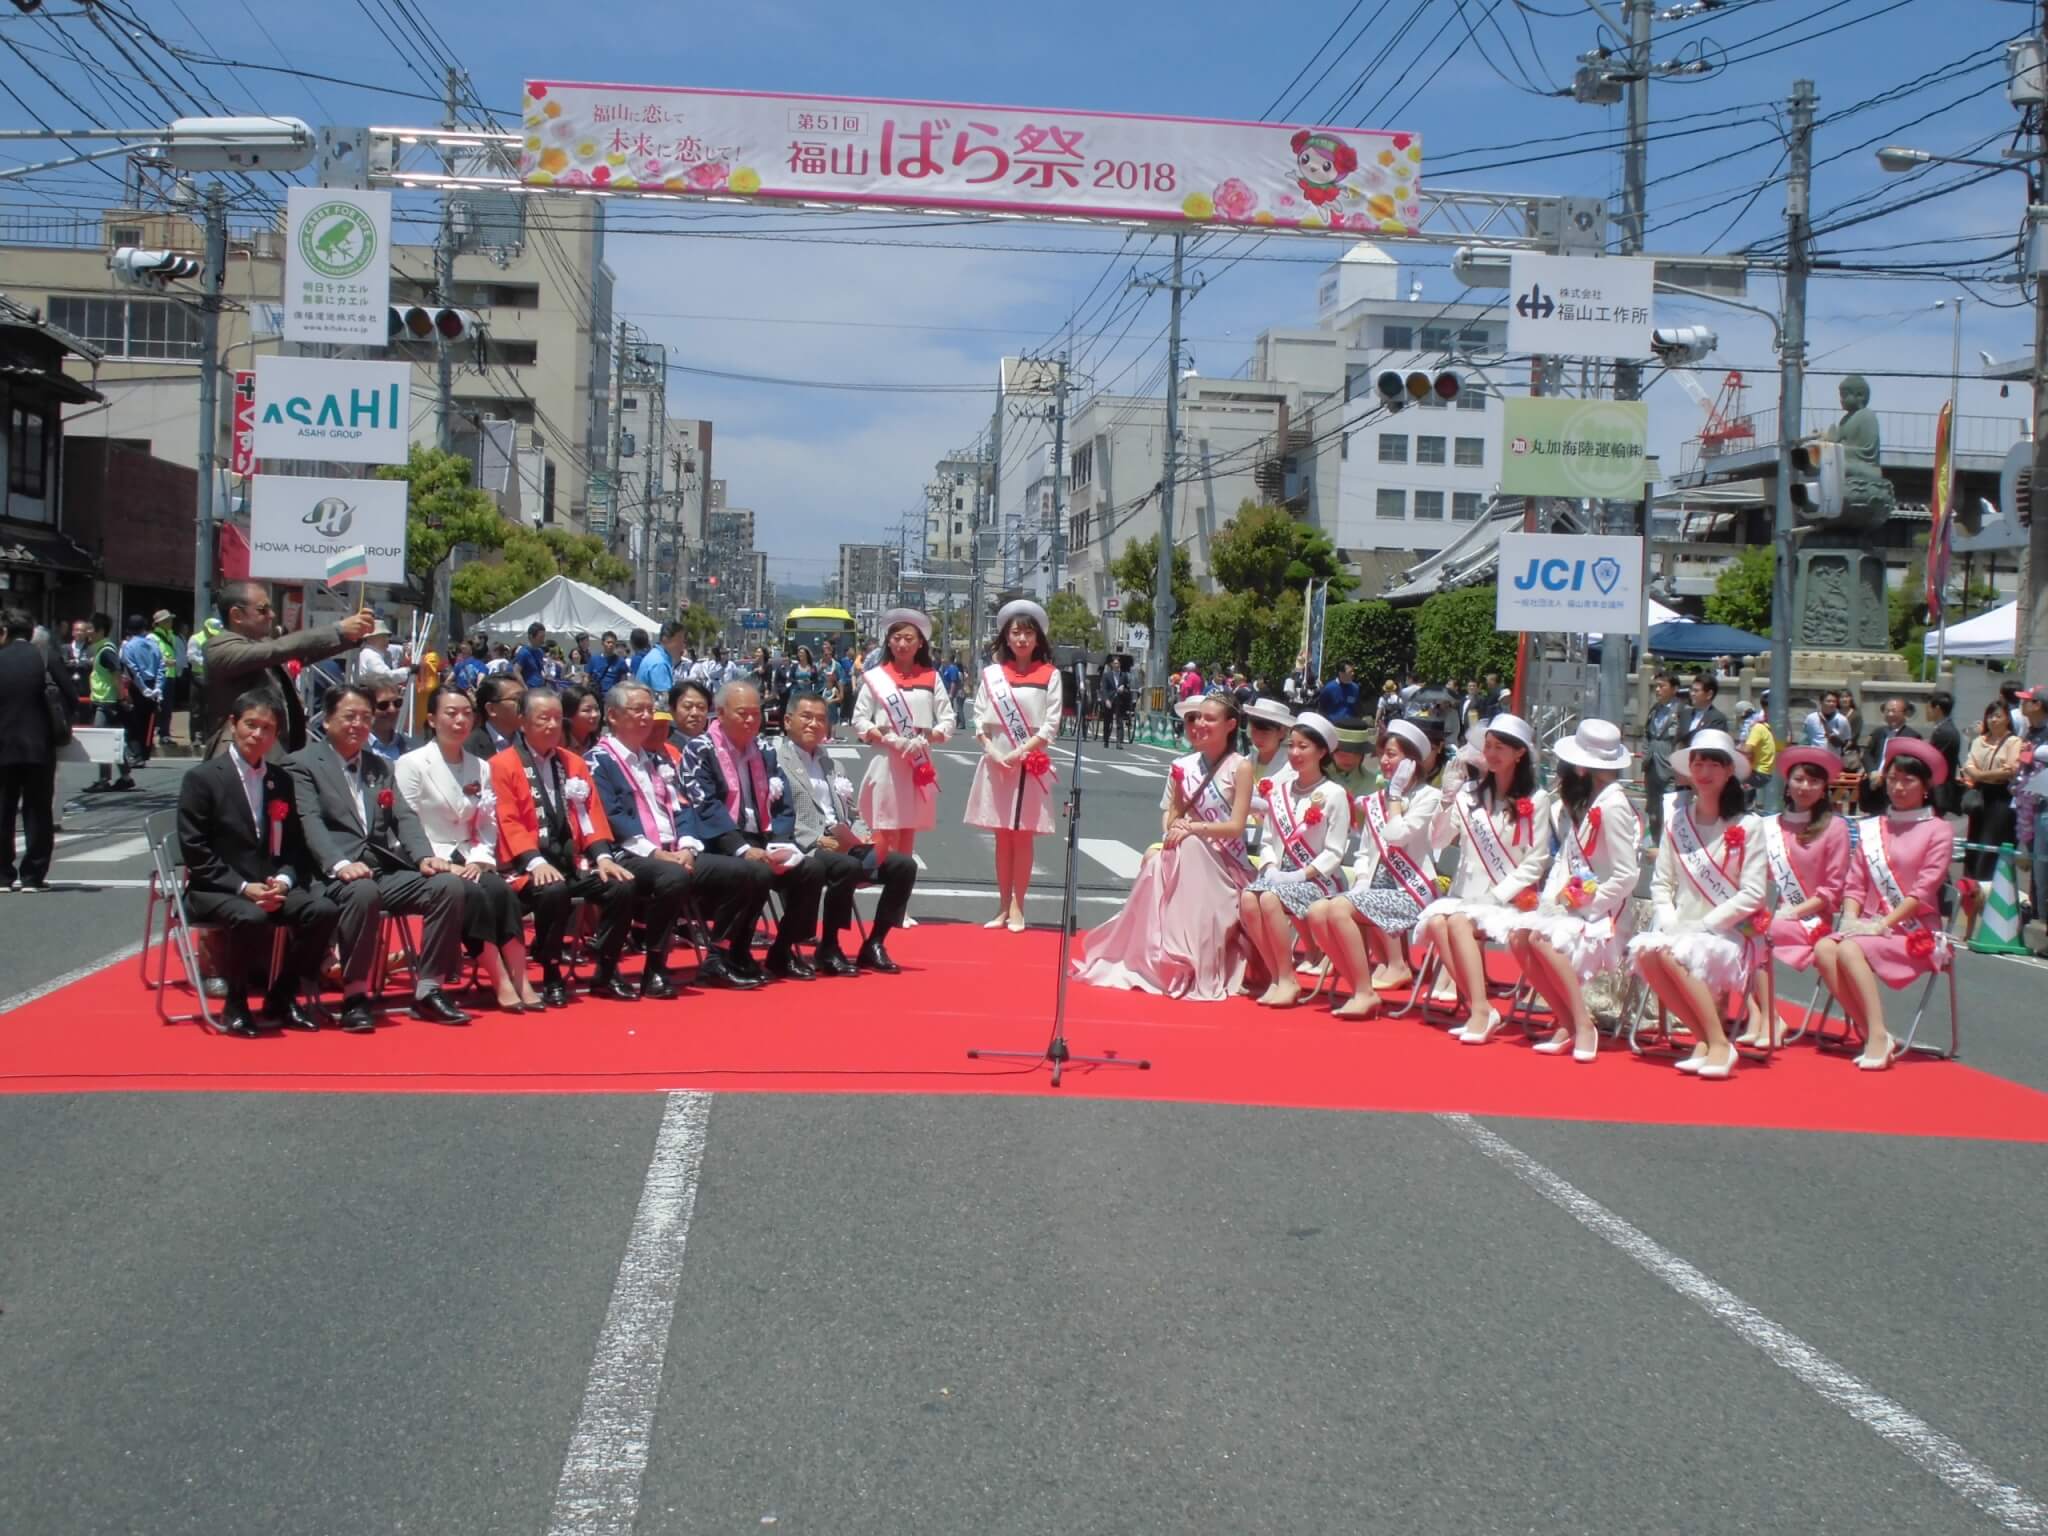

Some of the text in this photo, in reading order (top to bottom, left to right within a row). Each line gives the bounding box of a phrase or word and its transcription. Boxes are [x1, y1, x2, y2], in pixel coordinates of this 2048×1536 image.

[594, 103, 685, 124] 福山に恋して
[798, 113, 860, 133] 第51回
[787, 118, 1176, 193] 福山ばら祭 2018
[1560, 287, 1602, 300] 株式会社
[1557, 303, 1648, 325] 福山工作所
[262, 383, 399, 430] ASAHI
[298, 429, 362, 439] ASAHI GROUP
[255, 542, 290, 552] HOWA
[364, 546, 401, 557] ROUP
[1514, 559, 1585, 591] JCI
